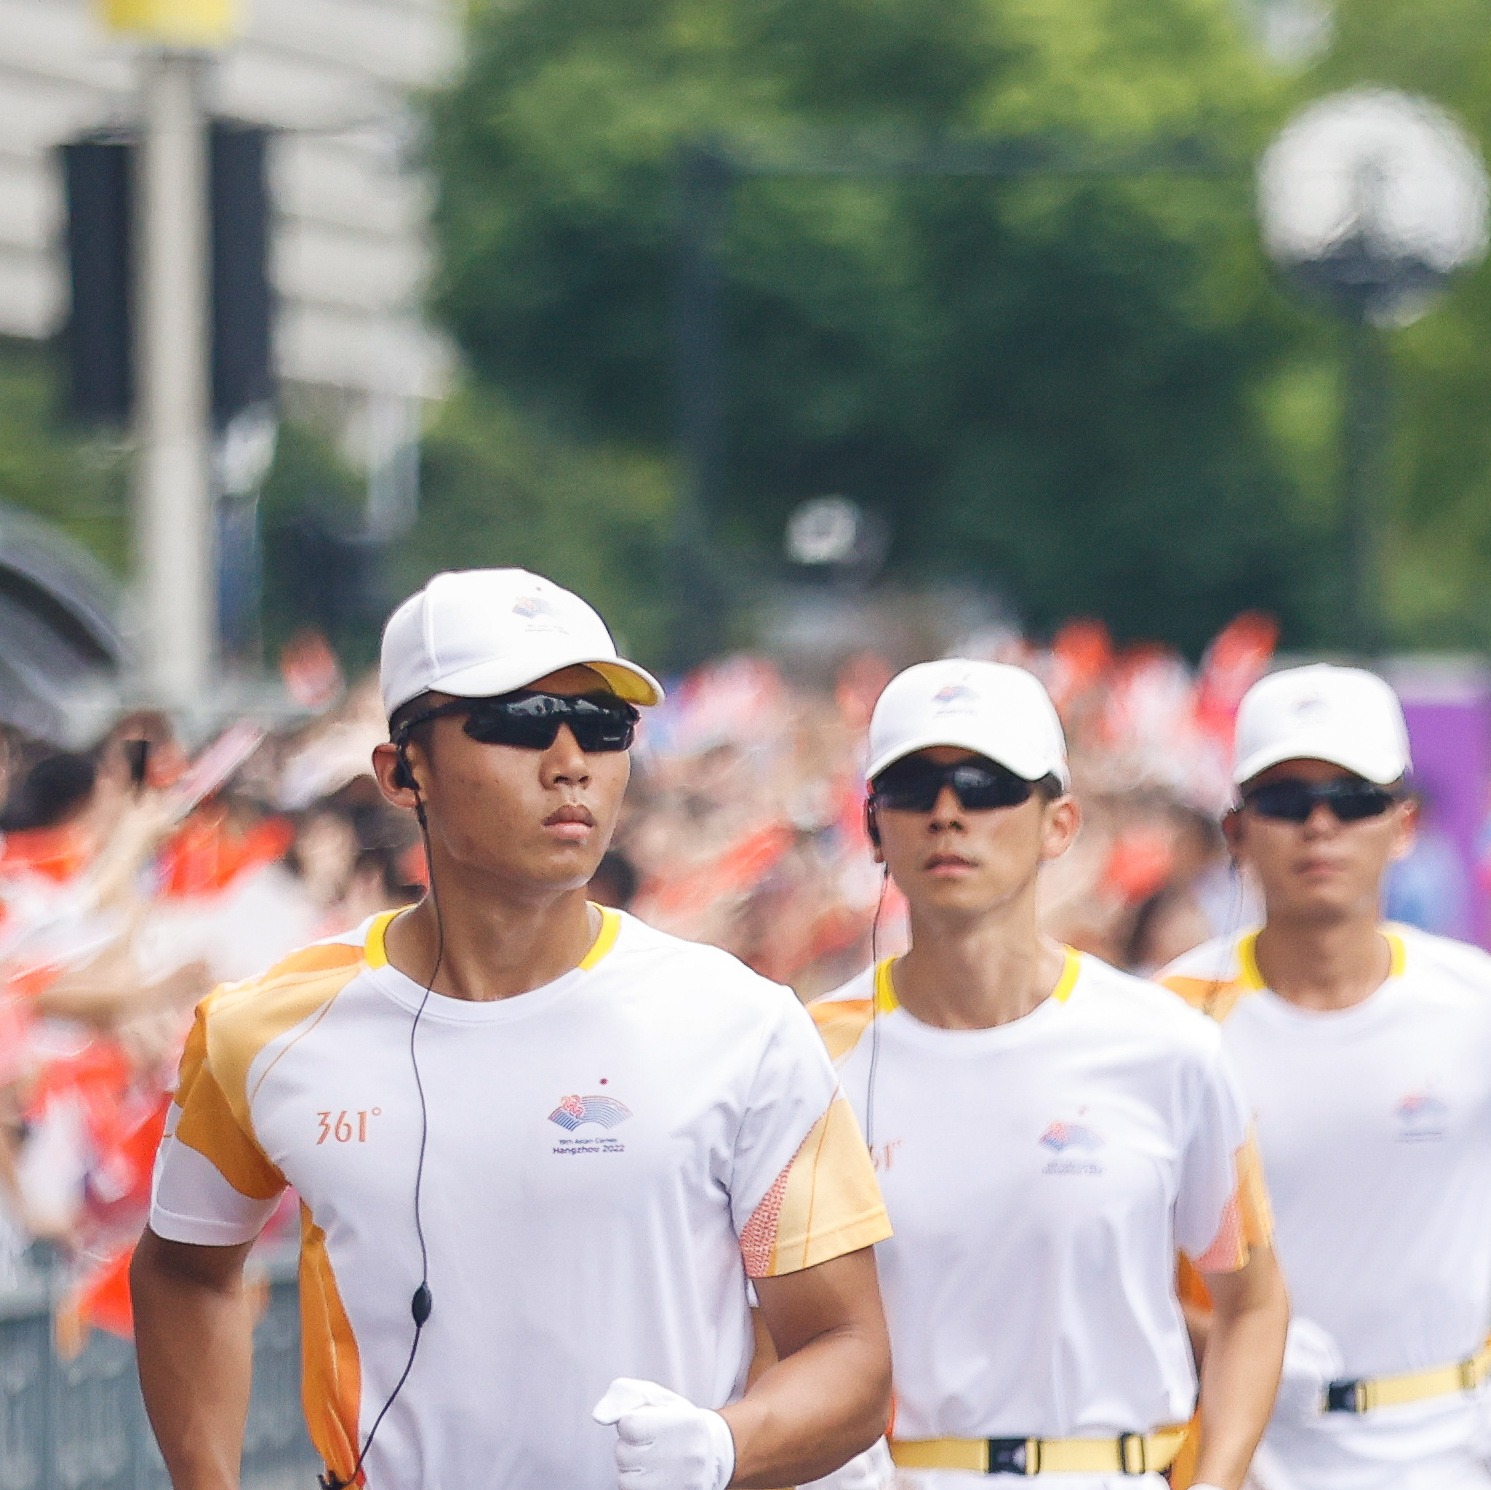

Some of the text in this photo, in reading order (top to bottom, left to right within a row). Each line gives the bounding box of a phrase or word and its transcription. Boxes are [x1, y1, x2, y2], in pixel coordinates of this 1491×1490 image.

[316, 1106, 382, 1145] 361°
[553, 1144, 625, 1156] Hangzhou 2022
